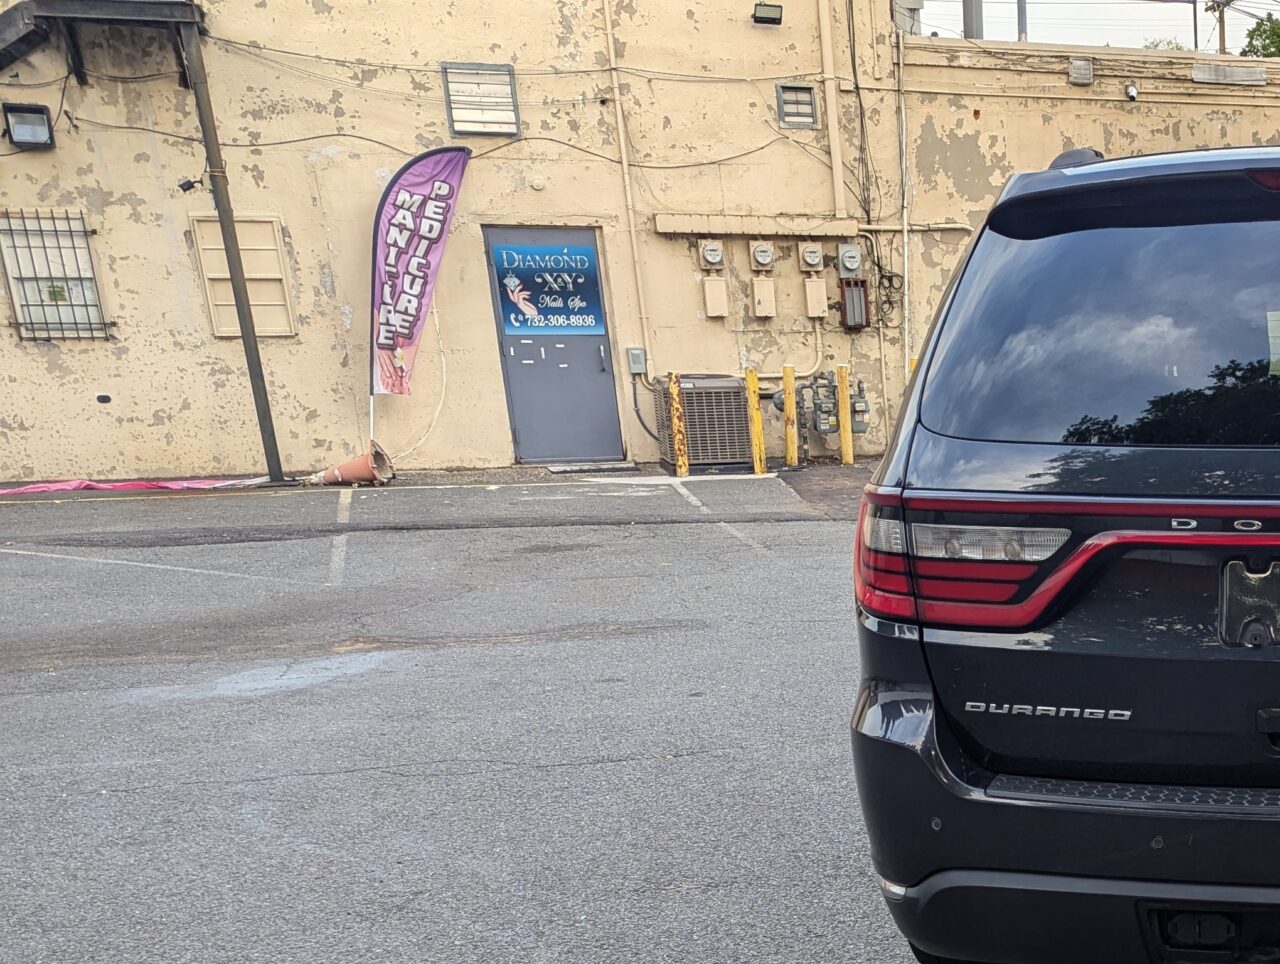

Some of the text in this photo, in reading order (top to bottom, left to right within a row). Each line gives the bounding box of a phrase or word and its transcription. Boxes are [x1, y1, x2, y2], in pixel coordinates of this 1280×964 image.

[394, 180, 450, 334] PEDICURE
[538, 294, 588, 312] Nails Spa
[525, 314, 596, 327] 732-306-8936
[964, 701, 1132, 720] DURANGO
